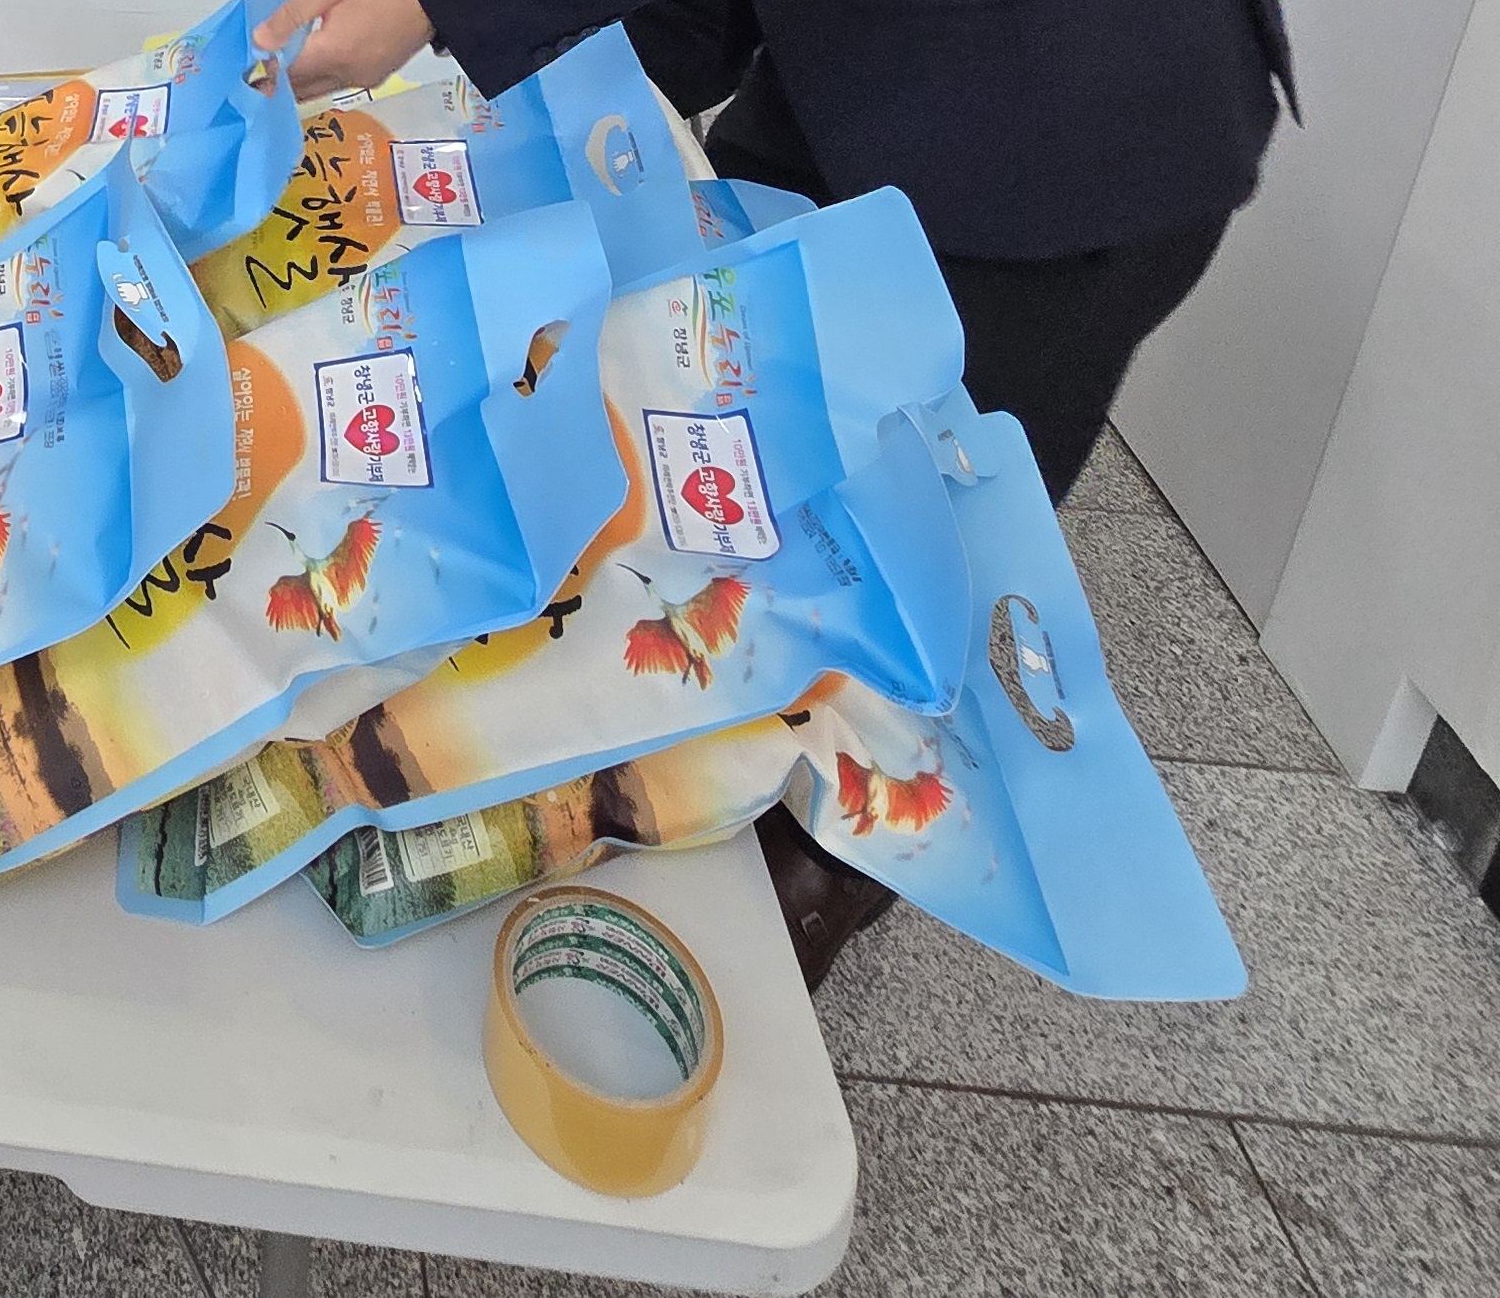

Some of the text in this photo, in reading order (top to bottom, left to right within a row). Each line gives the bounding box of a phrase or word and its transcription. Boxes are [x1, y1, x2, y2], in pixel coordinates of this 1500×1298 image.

[422, 146, 436, 170] 창녕군
[375, 262, 402, 329] 포누리
[4, 348, 15, 376] 10만원
[674, 328, 690, 368] 창녕군
[354, 366, 373, 405] 창녕군
[395, 374, 406, 401] 10만원
[400, 402, 411, 428] 기부하면
[232, 366, 254, 501] 살아있는 자연사 박물관!
[689, 423, 710, 465] 창녕군
[734, 439, 745, 468] 10만원
[242, 777, 261, 810] 국내산
[455, 815, 474, 851] 국내산
